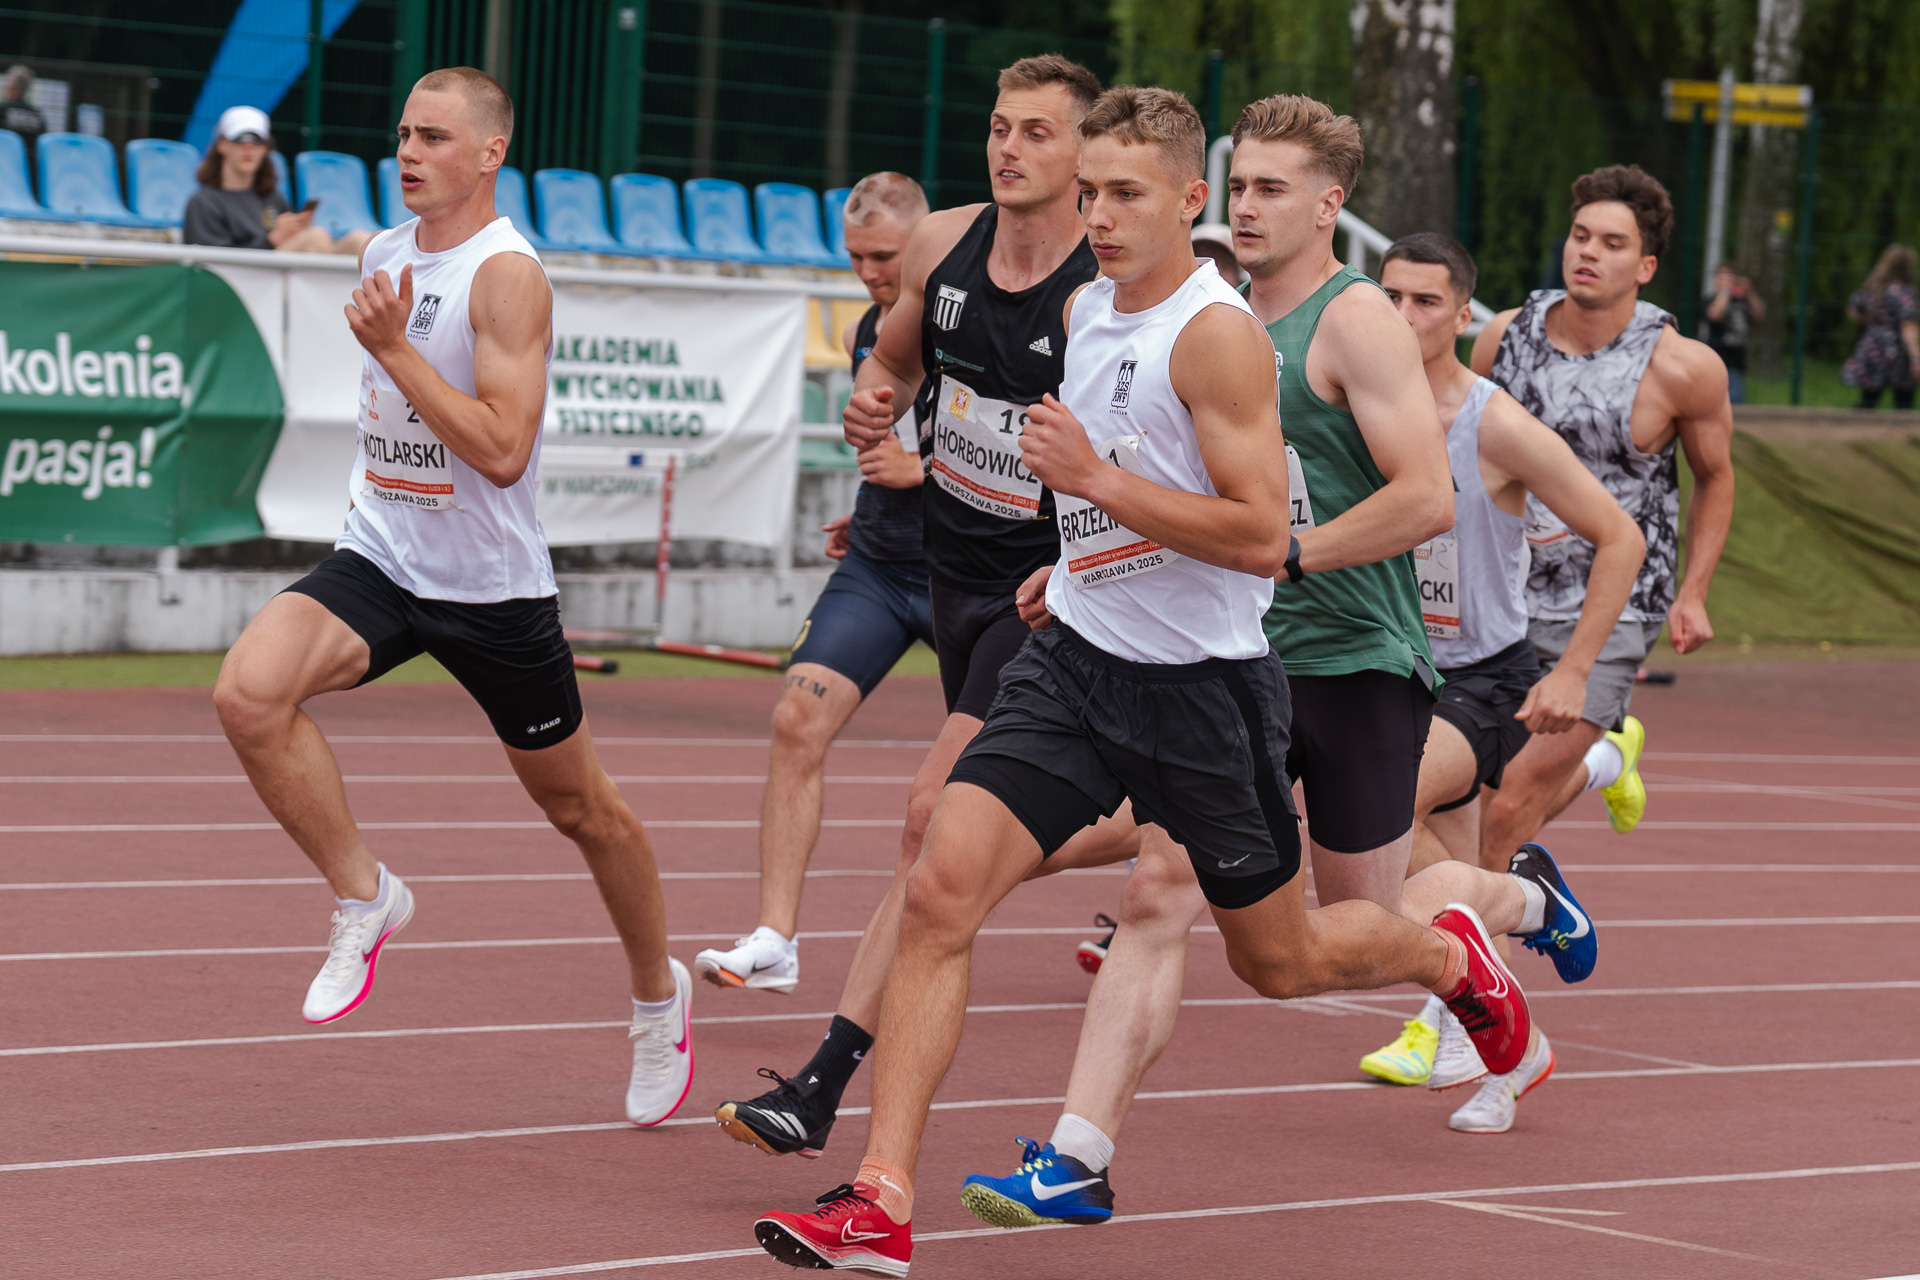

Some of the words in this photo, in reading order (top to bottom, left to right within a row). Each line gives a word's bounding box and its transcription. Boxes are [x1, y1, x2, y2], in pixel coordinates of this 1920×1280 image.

[415, 310, 433, 321] AZS
[554, 336, 680, 366] AKADEMIA
[1029, 343, 1053, 356] adidas
[553, 374, 725, 402] WYCHOWANIA
[1114, 380, 1130, 392] AZS
[558, 408, 704, 438] FIZYCZNEGO
[0, 425, 157, 500] pasja!
[364, 430, 446, 469] KOTLARSKI
[416, 496, 439, 507] 2025
[942, 477, 993, 511] WARSZAWA
[994, 503, 1021, 518] 2025
[1290, 499, 1308, 526] Z
[1136, 554, 1164, 570] 2025
[1420, 579, 1454, 604] CKI
[539, 717, 561, 731] JAKO
